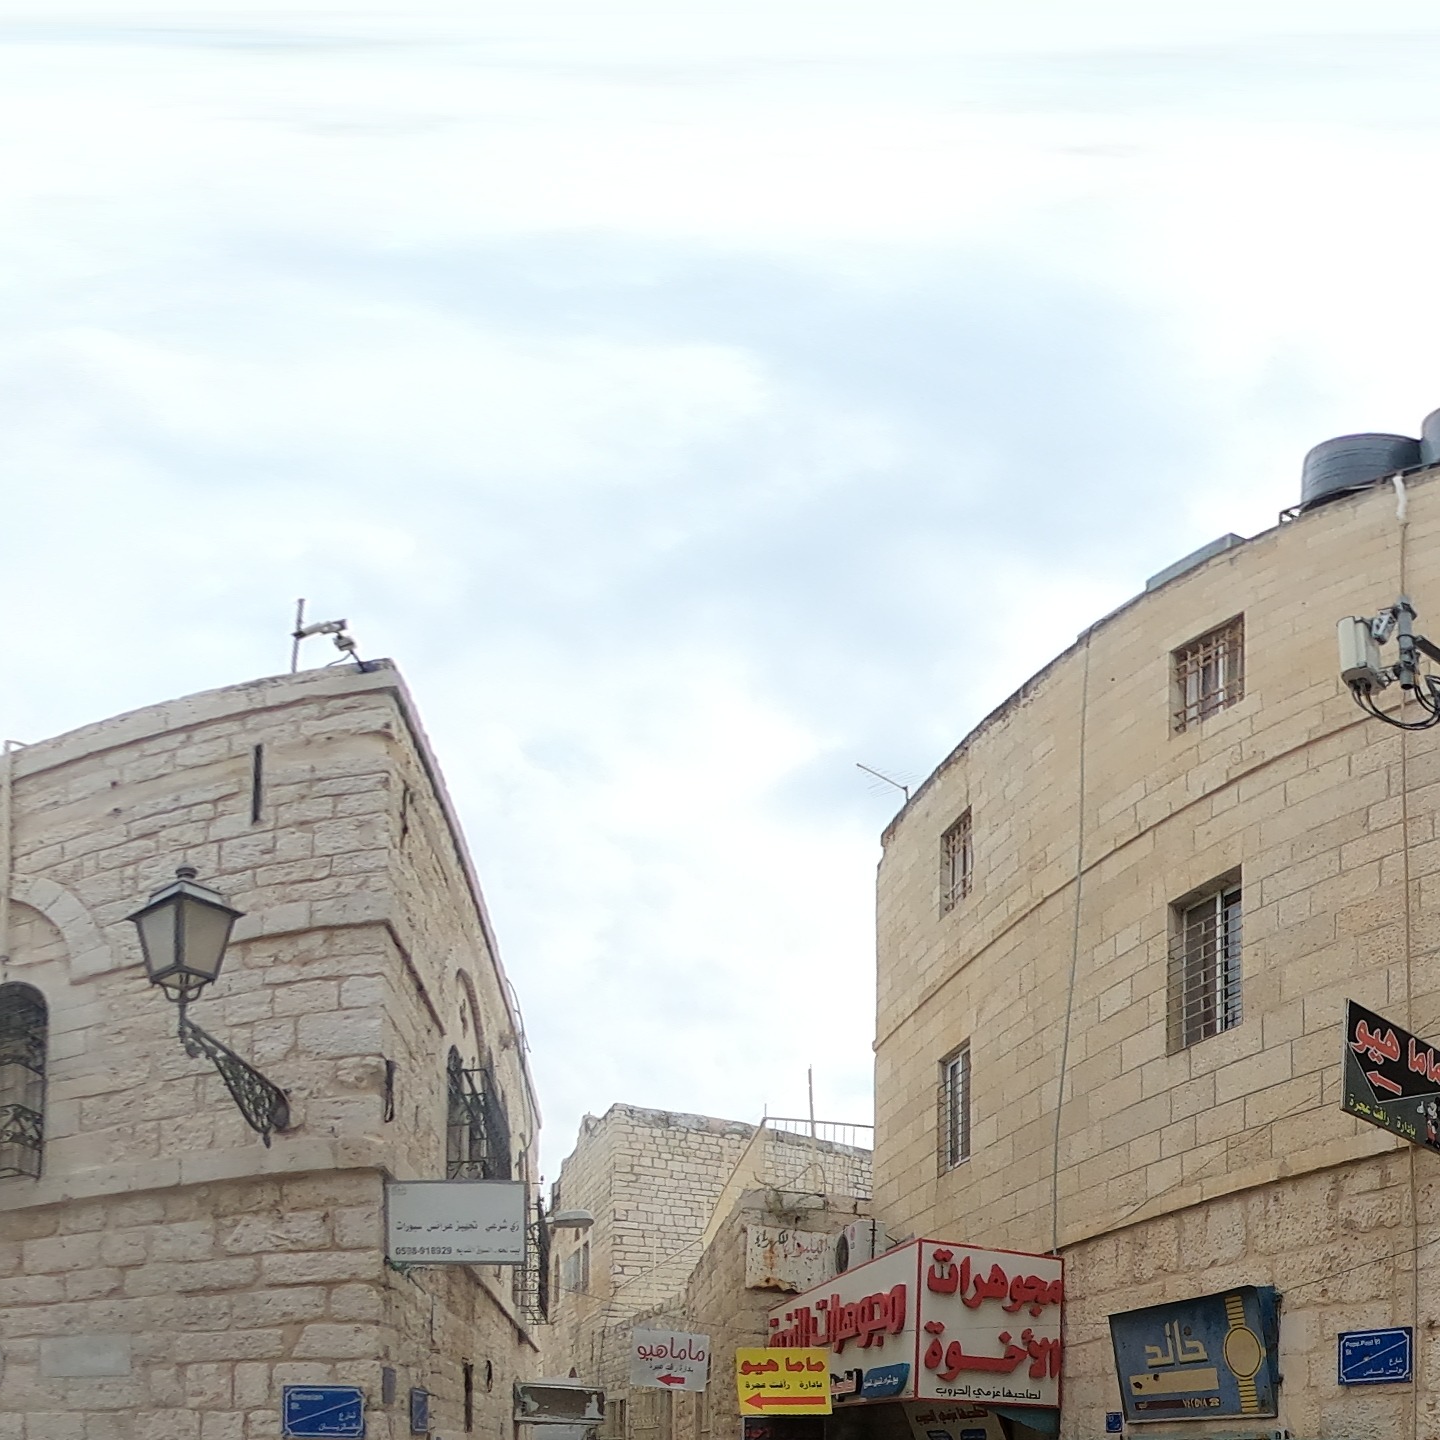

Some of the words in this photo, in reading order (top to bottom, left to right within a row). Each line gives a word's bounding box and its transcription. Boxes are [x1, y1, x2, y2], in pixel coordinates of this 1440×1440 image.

[1350, 1019, 1400, 1065] هيو
[928, 1248, 1063, 1317] مجوهرات
[811, 1284, 906, 1354] مجوهرات
[739, 1358, 779, 1376] هيو
[785, 1356, 826, 1373] ماما
[925, 1321, 1061, 1382] الأخوة
